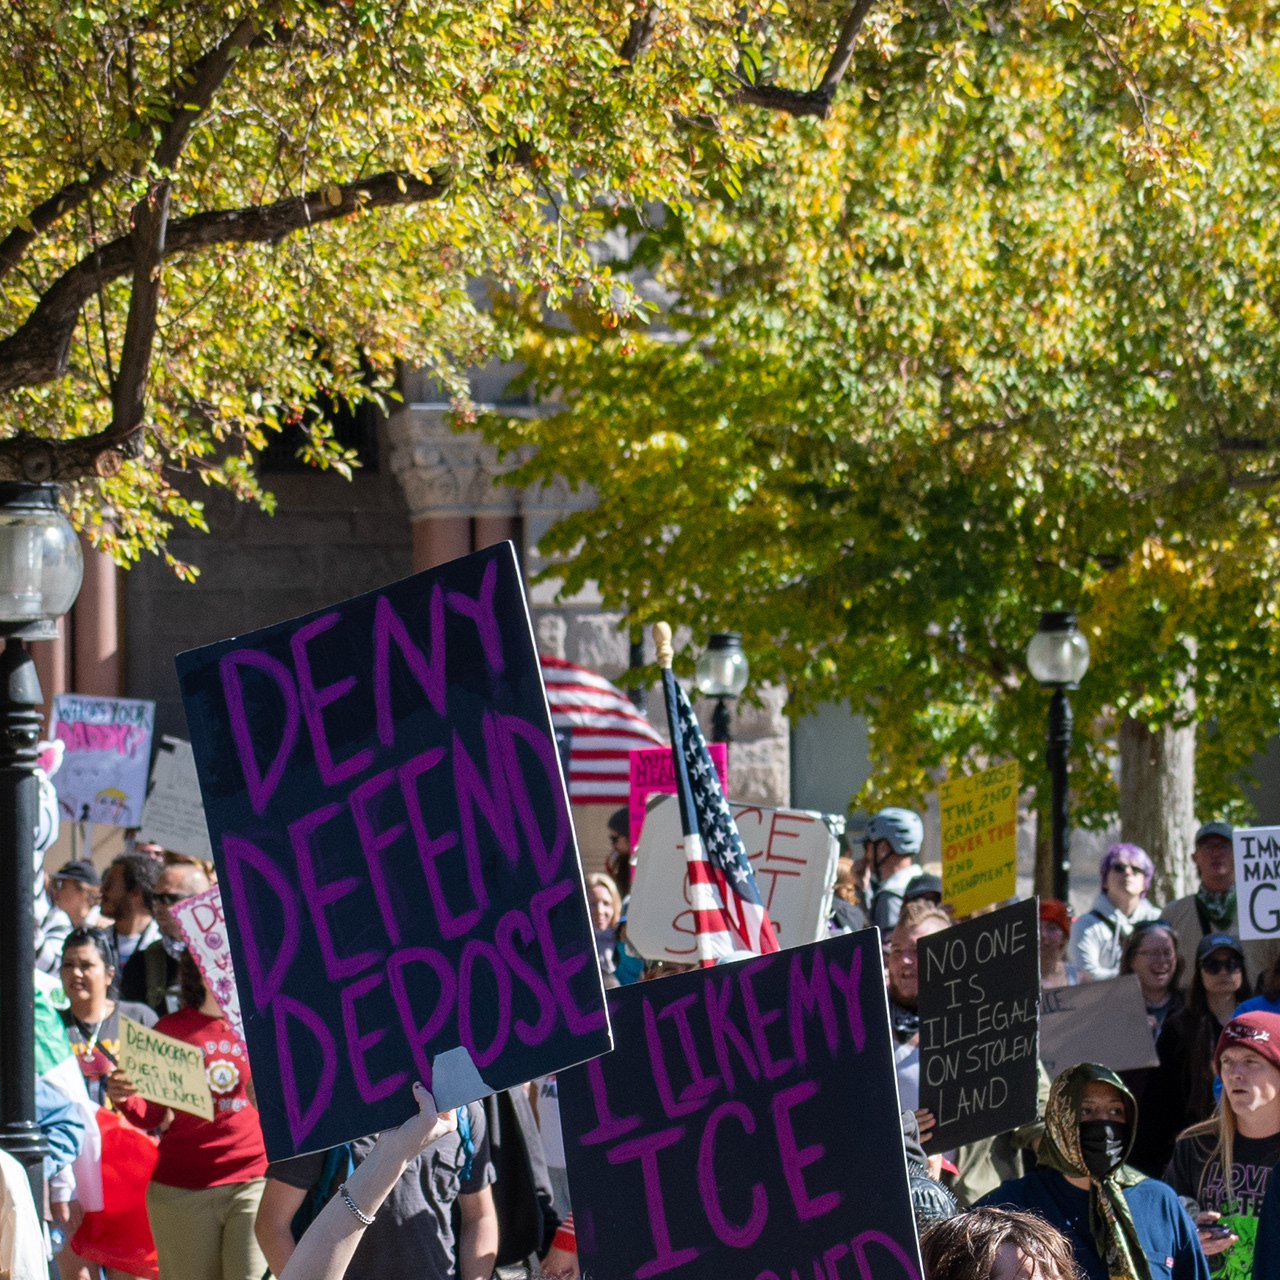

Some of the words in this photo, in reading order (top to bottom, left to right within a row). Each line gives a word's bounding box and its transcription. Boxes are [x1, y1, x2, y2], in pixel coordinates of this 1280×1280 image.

[221, 559, 505, 814] DENY
[943, 800, 973, 820] THE
[978, 785, 1012, 811] 2ND
[221, 708, 575, 1017] DEFEND
[945, 834, 983, 861] OVER
[946, 858, 974, 880] 2ND
[926, 939, 967, 982] NO
[975, 920, 1027, 963] ONE
[273, 878, 607, 1153] DEPOSE
[943, 973, 985, 1009] IS
[126, 1023, 201, 1069] DEMOCRACY
[579, 1055, 641, 1145] I
[643, 953, 792, 1118] LIKE
[787, 945, 867, 1063] MY
[923, 998, 1037, 1051] ILLEGAL
[126, 1056, 159, 1076] DIES
[169, 1072, 183, 1086] IN
[926, 1051, 960, 1086] ON
[965, 1032, 1035, 1073] STOLEN
[135, 1079, 207, 1111] SILENCE!
[939, 1077, 1008, 1127] LAND
[607, 1080, 842, 1280] ICE
